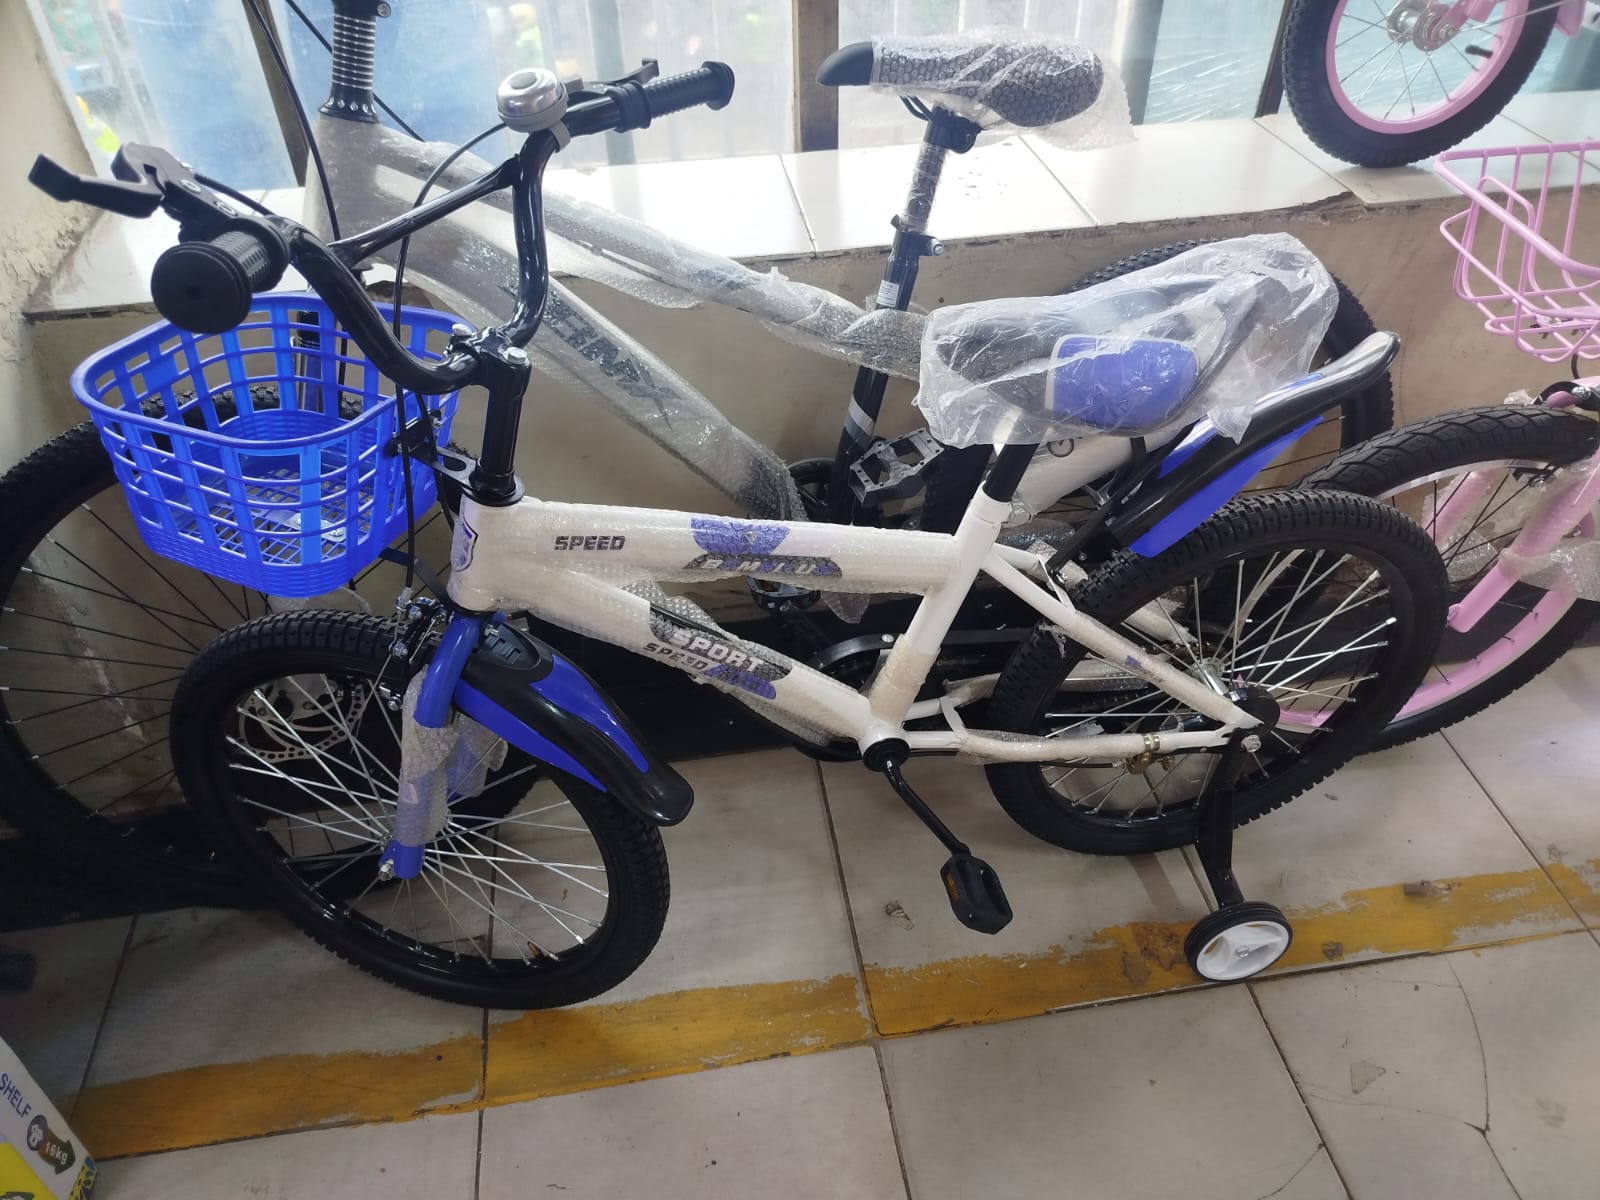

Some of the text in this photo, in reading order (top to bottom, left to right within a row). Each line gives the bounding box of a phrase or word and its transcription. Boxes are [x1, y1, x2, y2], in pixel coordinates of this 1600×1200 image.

[554, 535, 626, 551] SPEED
[643, 642, 709, 671] SPEED
[668, 629, 765, 672] SPORT
[0, 1073, 32, 1118] SHELF
[45, 1141, 69, 1166] 16kg
